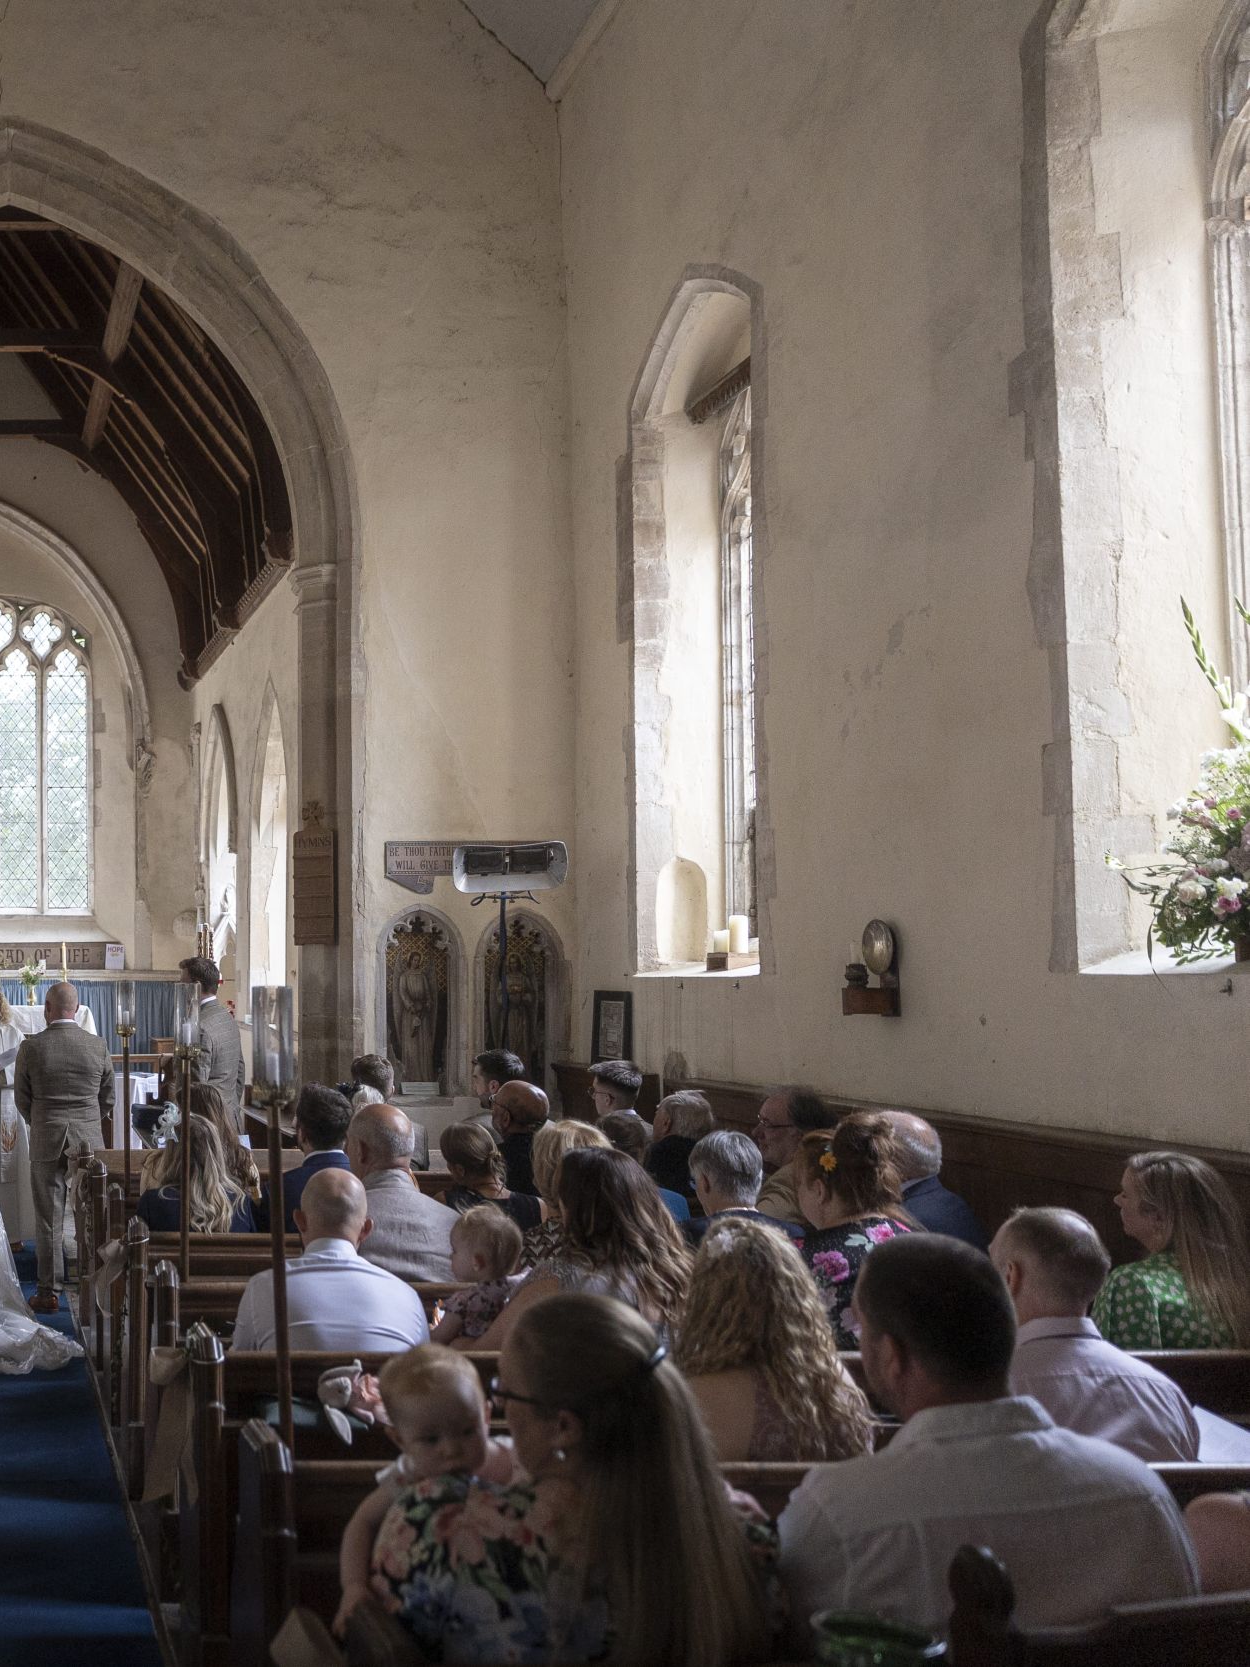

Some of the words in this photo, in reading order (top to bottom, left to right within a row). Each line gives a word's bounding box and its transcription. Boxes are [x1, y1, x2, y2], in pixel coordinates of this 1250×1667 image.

[294, 836, 332, 848] HYMNS
[389, 847, 400, 856] BE
[405, 847, 425, 857] THOU
[429, 847, 457, 857] FAITHF
[395, 860, 415, 870] WILL
[420, 860, 439, 870] GIVE
[444, 860, 454, 870] TH
[34, 948, 52, 964] OF
